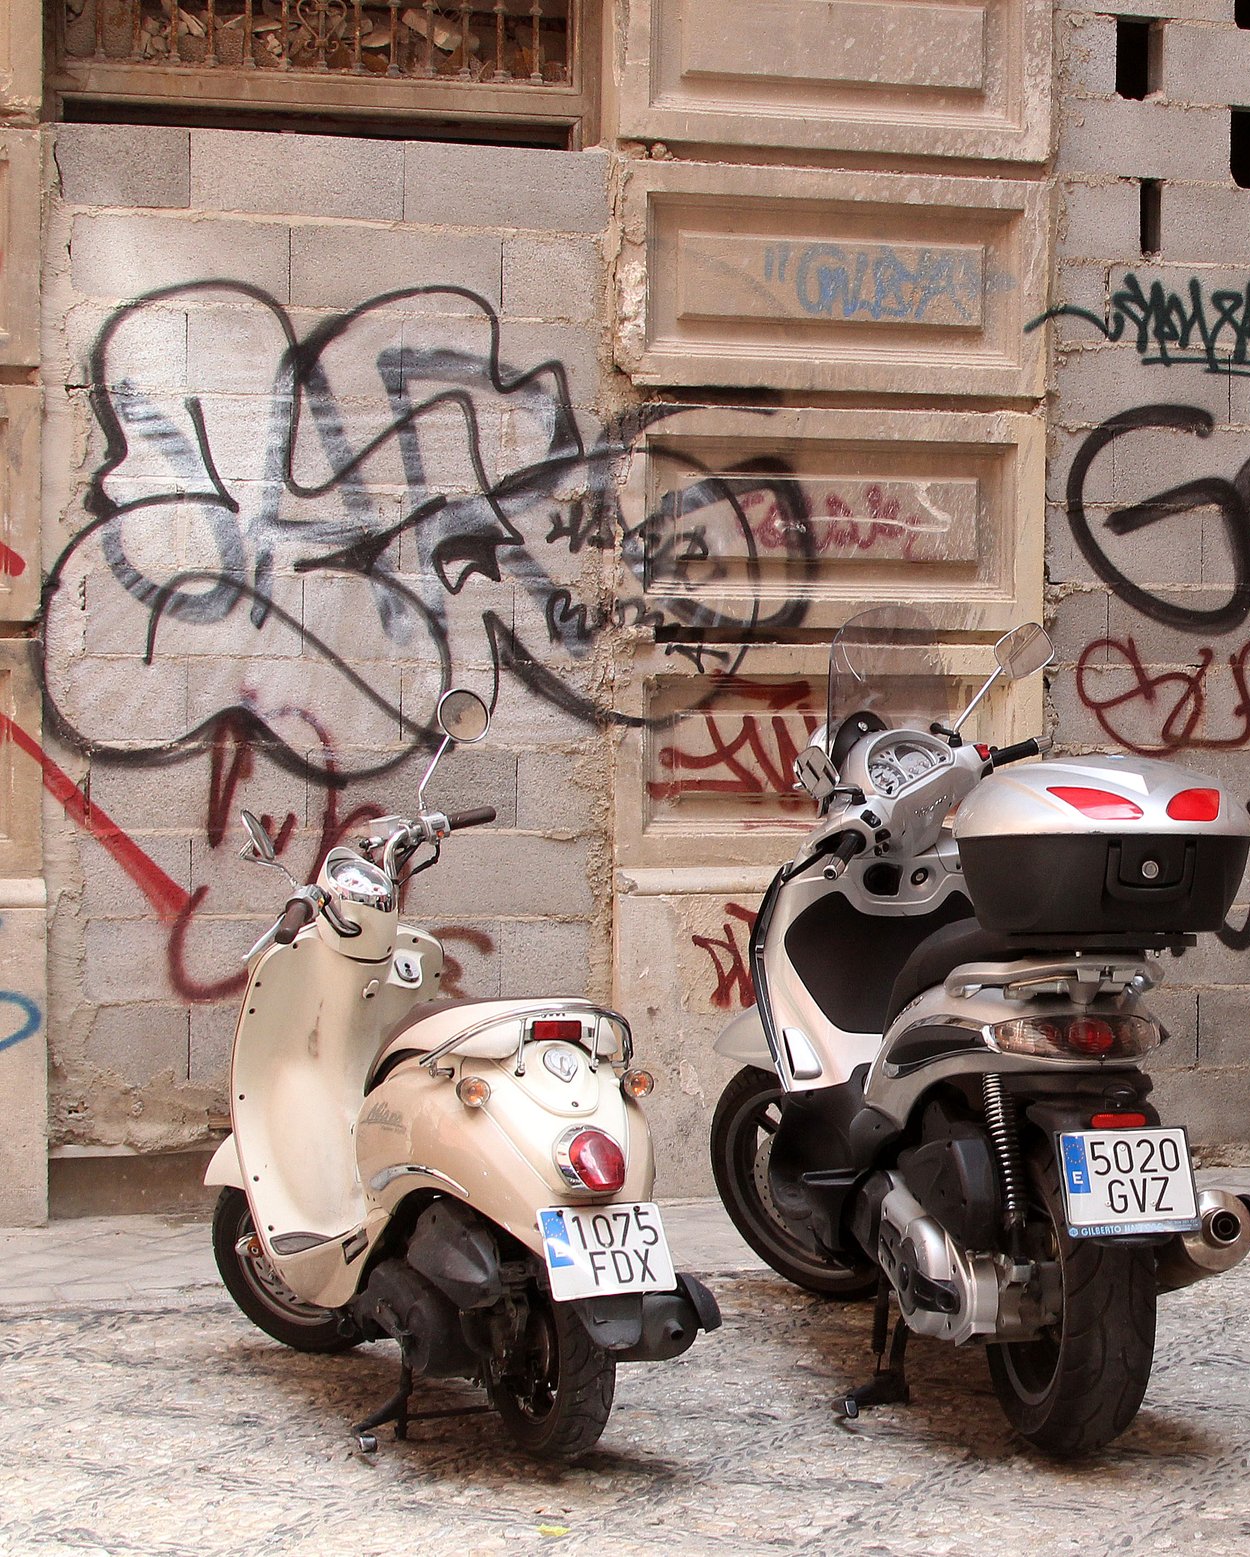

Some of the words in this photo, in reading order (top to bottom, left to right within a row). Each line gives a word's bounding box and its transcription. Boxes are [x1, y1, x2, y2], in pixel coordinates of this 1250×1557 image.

[1089, 1138, 1180, 1176] 5020
[1072, 1171, 1084, 1185] E
[1107, 1176, 1174, 1214] GVZ
[572, 1212, 659, 1250] 1075
[1081, 1225, 1122, 1236] GILBERTO
[589, 1248, 657, 1286] FDX
